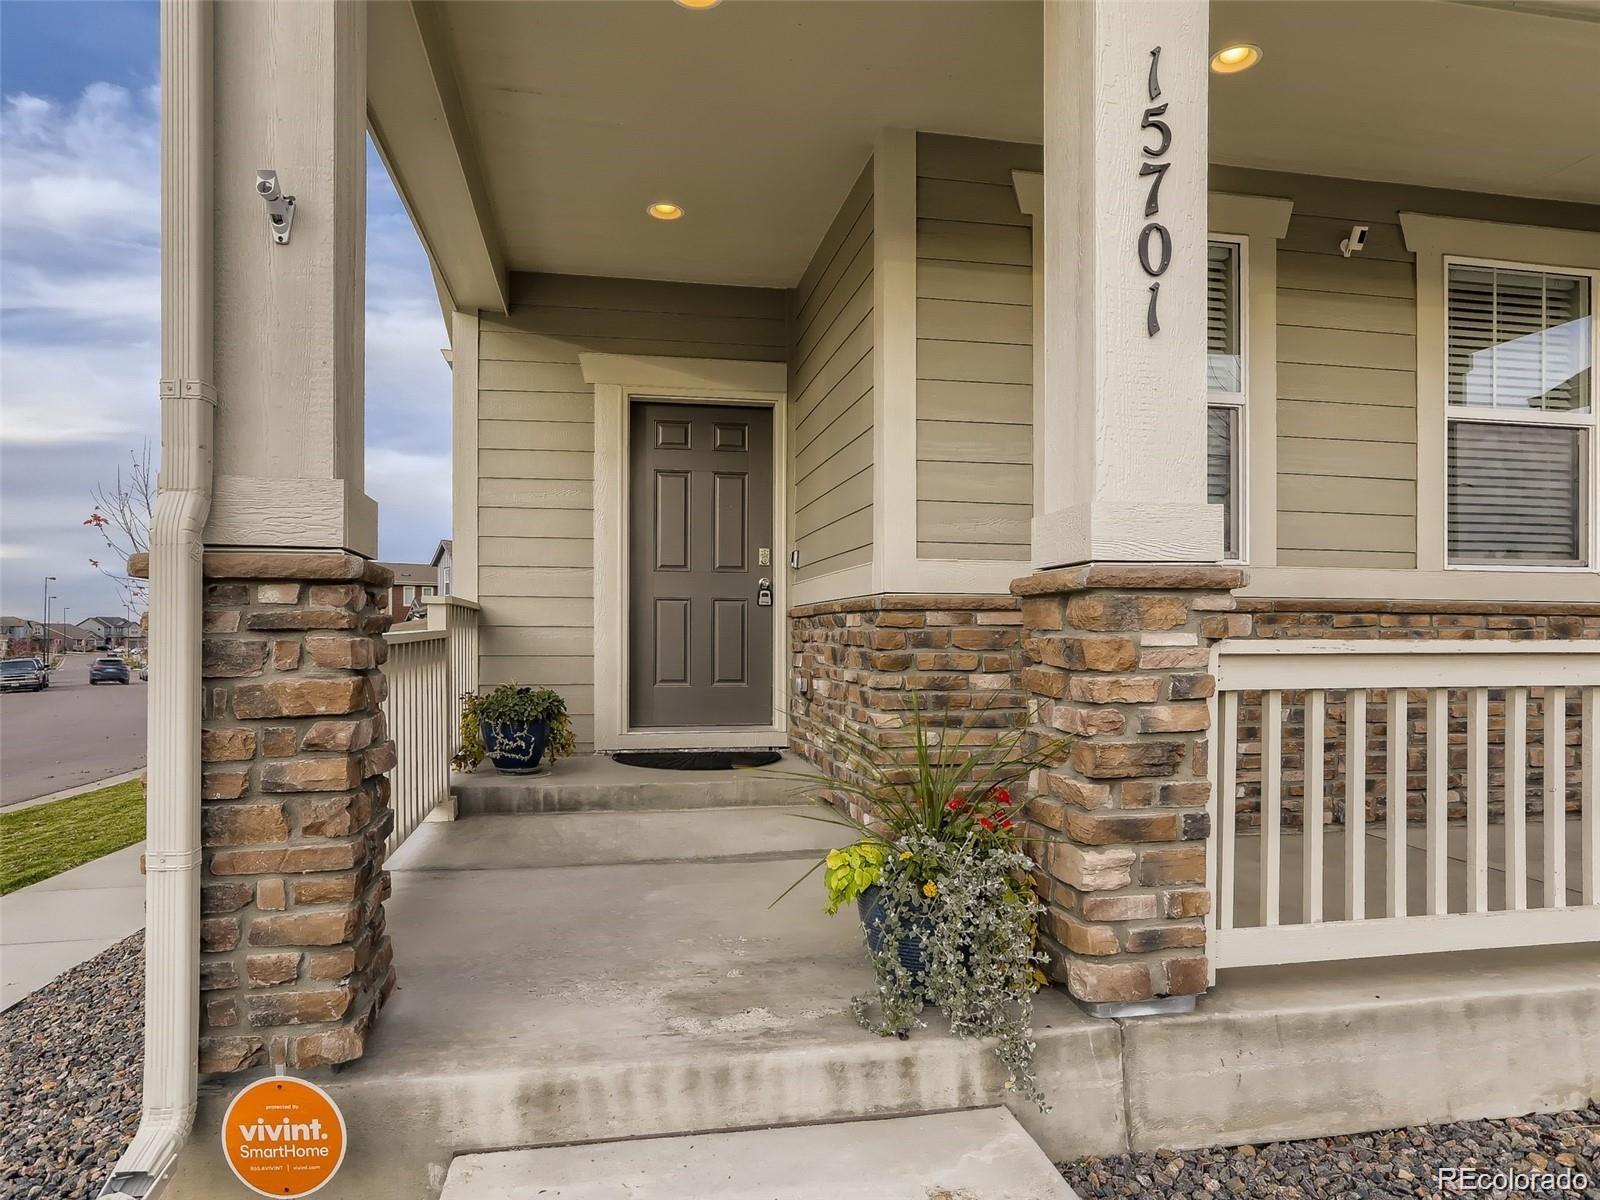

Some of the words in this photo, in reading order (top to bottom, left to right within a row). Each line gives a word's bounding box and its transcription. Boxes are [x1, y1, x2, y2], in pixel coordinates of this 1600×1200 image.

[1138, 46, 1172, 336] 15701
[239, 1117, 328, 1141] vivint.
[240, 1145, 329, 1158] SmartHome
